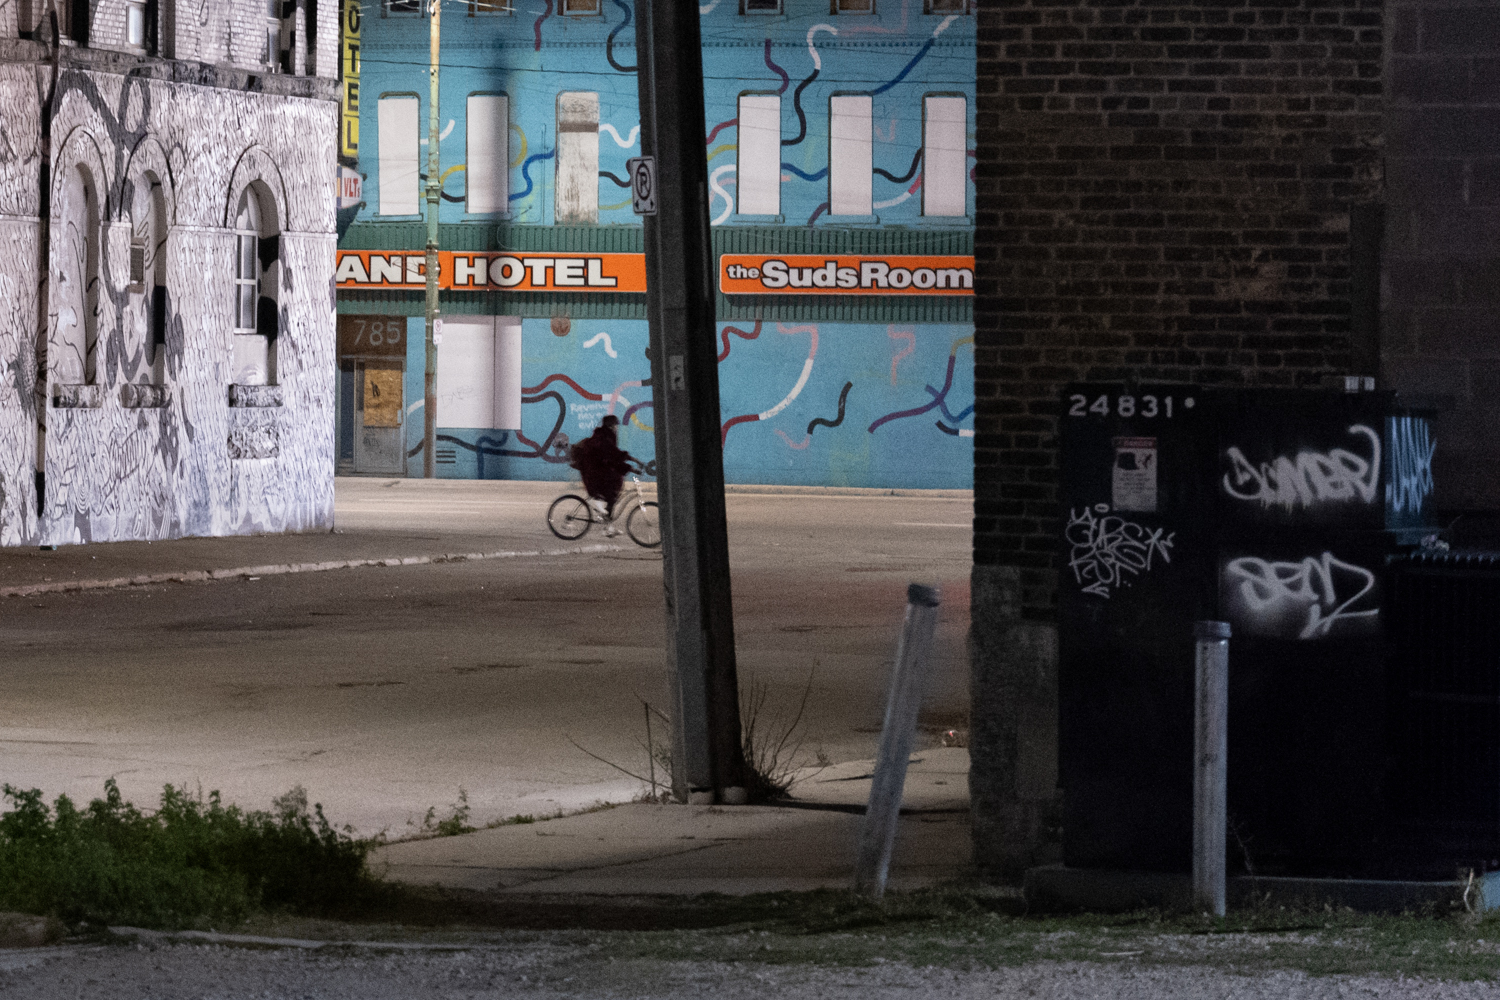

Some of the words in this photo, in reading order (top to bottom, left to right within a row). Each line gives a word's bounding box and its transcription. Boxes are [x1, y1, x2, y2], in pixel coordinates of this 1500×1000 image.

[453, 256, 618, 288] HOTEL
[726, 264, 760, 280] the
[353, 320, 400, 346] 785
